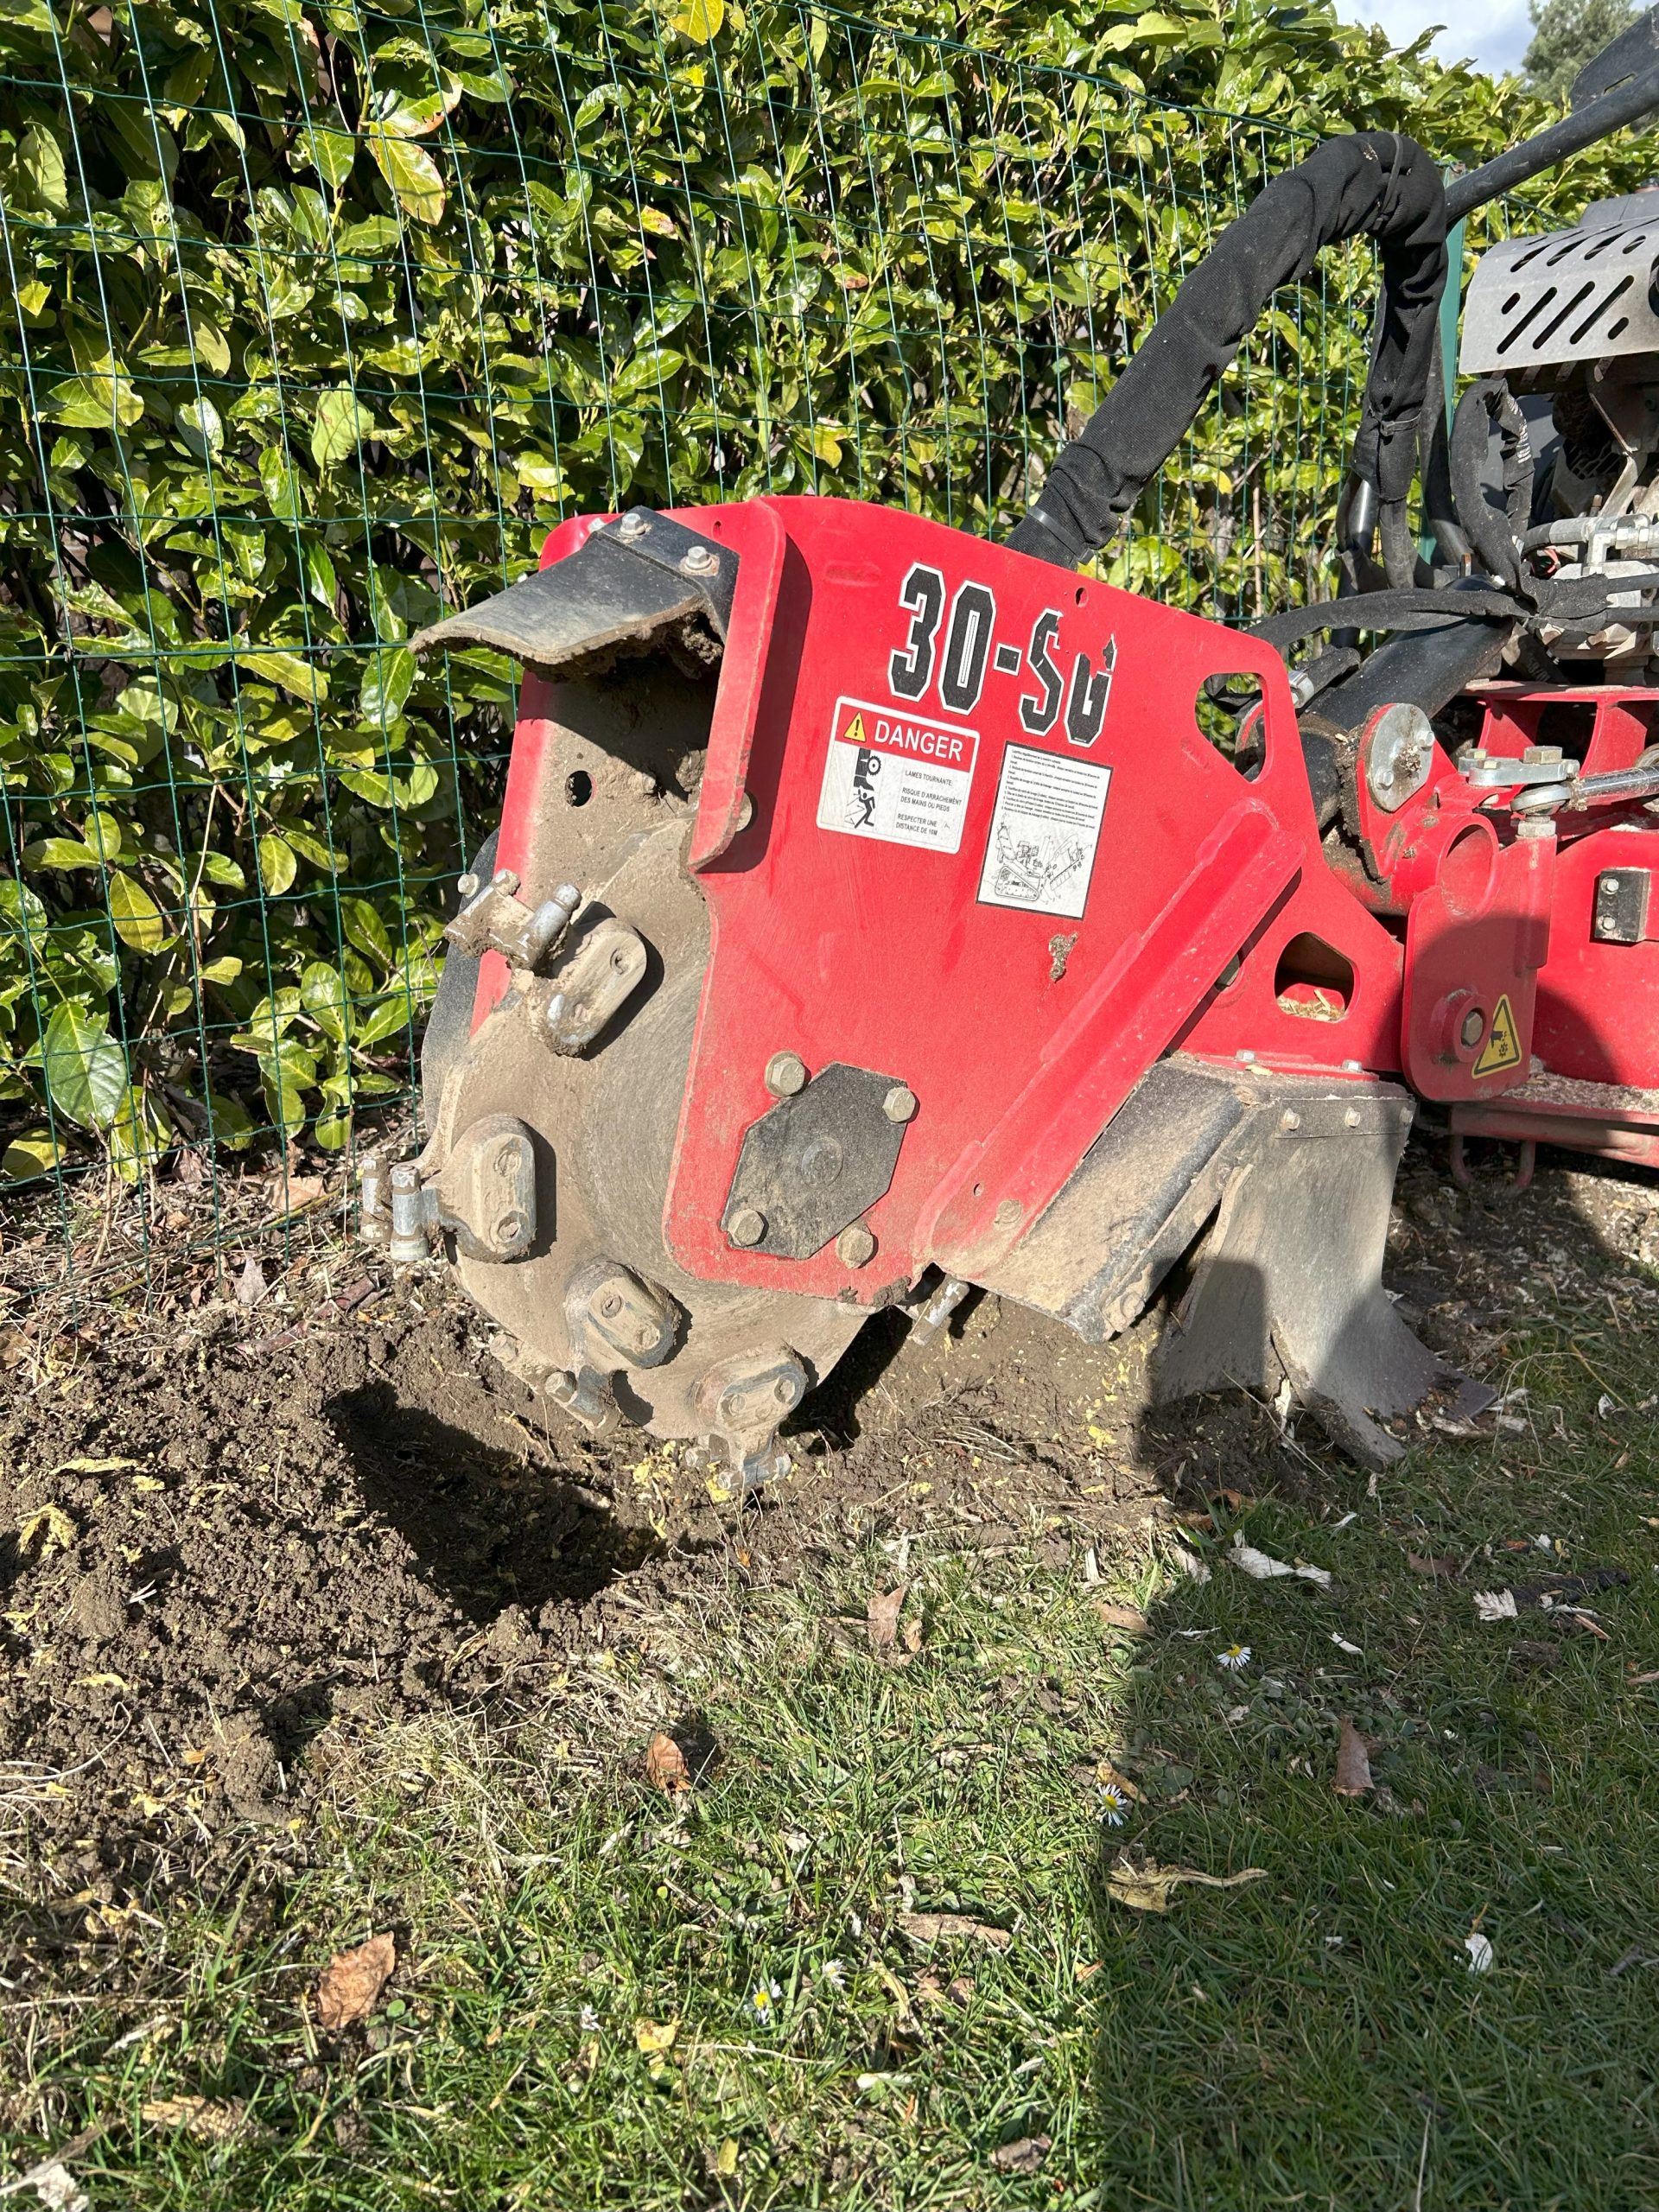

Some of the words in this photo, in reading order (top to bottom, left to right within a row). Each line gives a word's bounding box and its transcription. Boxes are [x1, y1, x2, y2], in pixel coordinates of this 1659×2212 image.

[874, 720, 963, 762] DANGER
[905, 770, 923, 779] LAMES
[902, 787, 920, 797] RISQUE
[912, 798, 927, 807] MAINS
[936, 804, 950, 812] PIEDS
[897, 813, 927, 824] RESPECTER
[895, 822, 919, 832] DISTANCE
